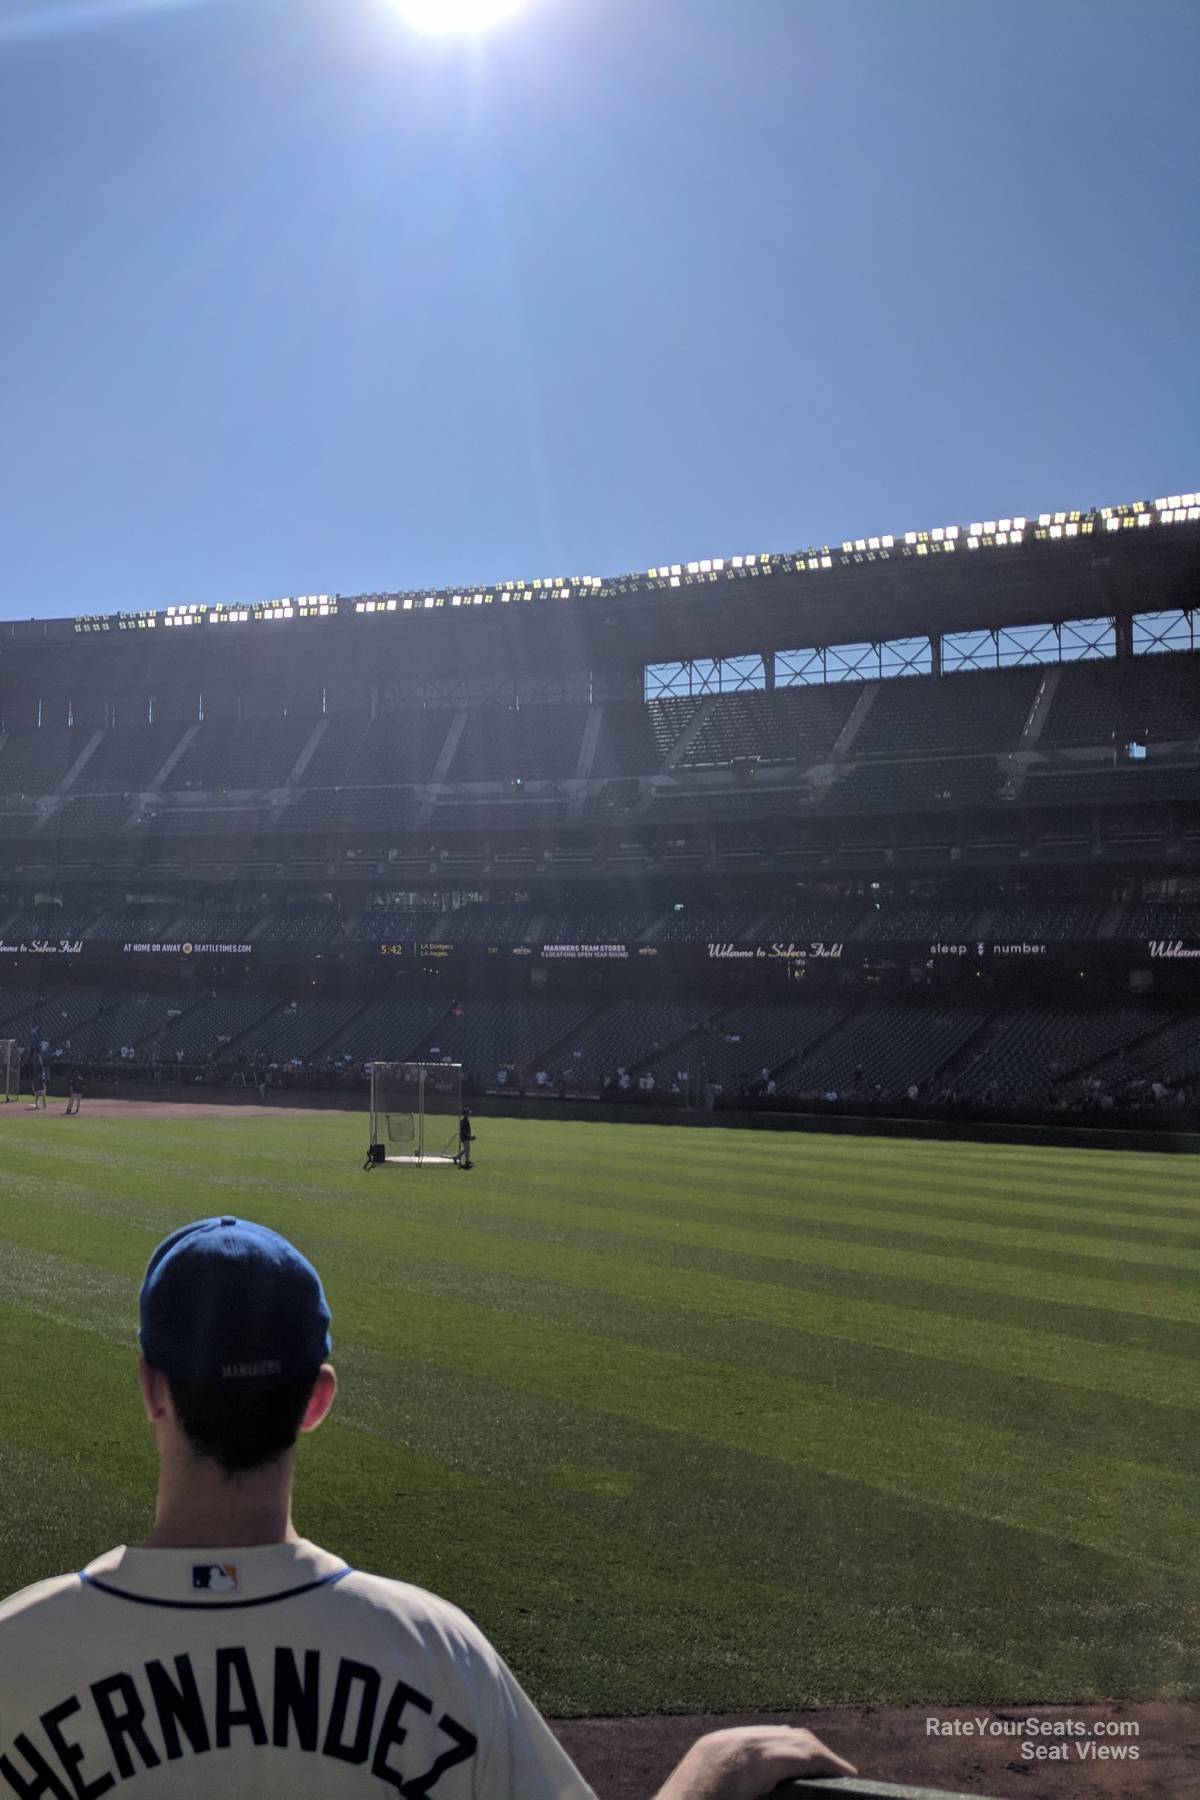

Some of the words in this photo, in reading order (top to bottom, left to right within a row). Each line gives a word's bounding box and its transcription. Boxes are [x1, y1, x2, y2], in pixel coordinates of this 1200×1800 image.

[19, 943, 27, 952] to
[29, 939, 57, 953] Safeco
[58, 940, 83, 953] Field
[123, 943, 132, 952] AT
[133, 943, 150, 952] HOME
[151, 943, 161, 952] OR
[162, 943, 180, 953] AWAY
[194, 944, 252, 953] SEATTLETIMES.COM
[380, 944, 402, 955] 5:42
[543, 944, 579, 952] MARINERS
[580, 944, 599, 952] TEAM
[599, 944, 626, 952] STORES
[708, 943, 754, 958] Welcome
[756, 947, 766, 958] to
[768, 943, 807, 959] Safeco
[809, 942, 843, 959] Field
[930, 943, 967, 956] sleep
[993, 943, 1044, 955] number
